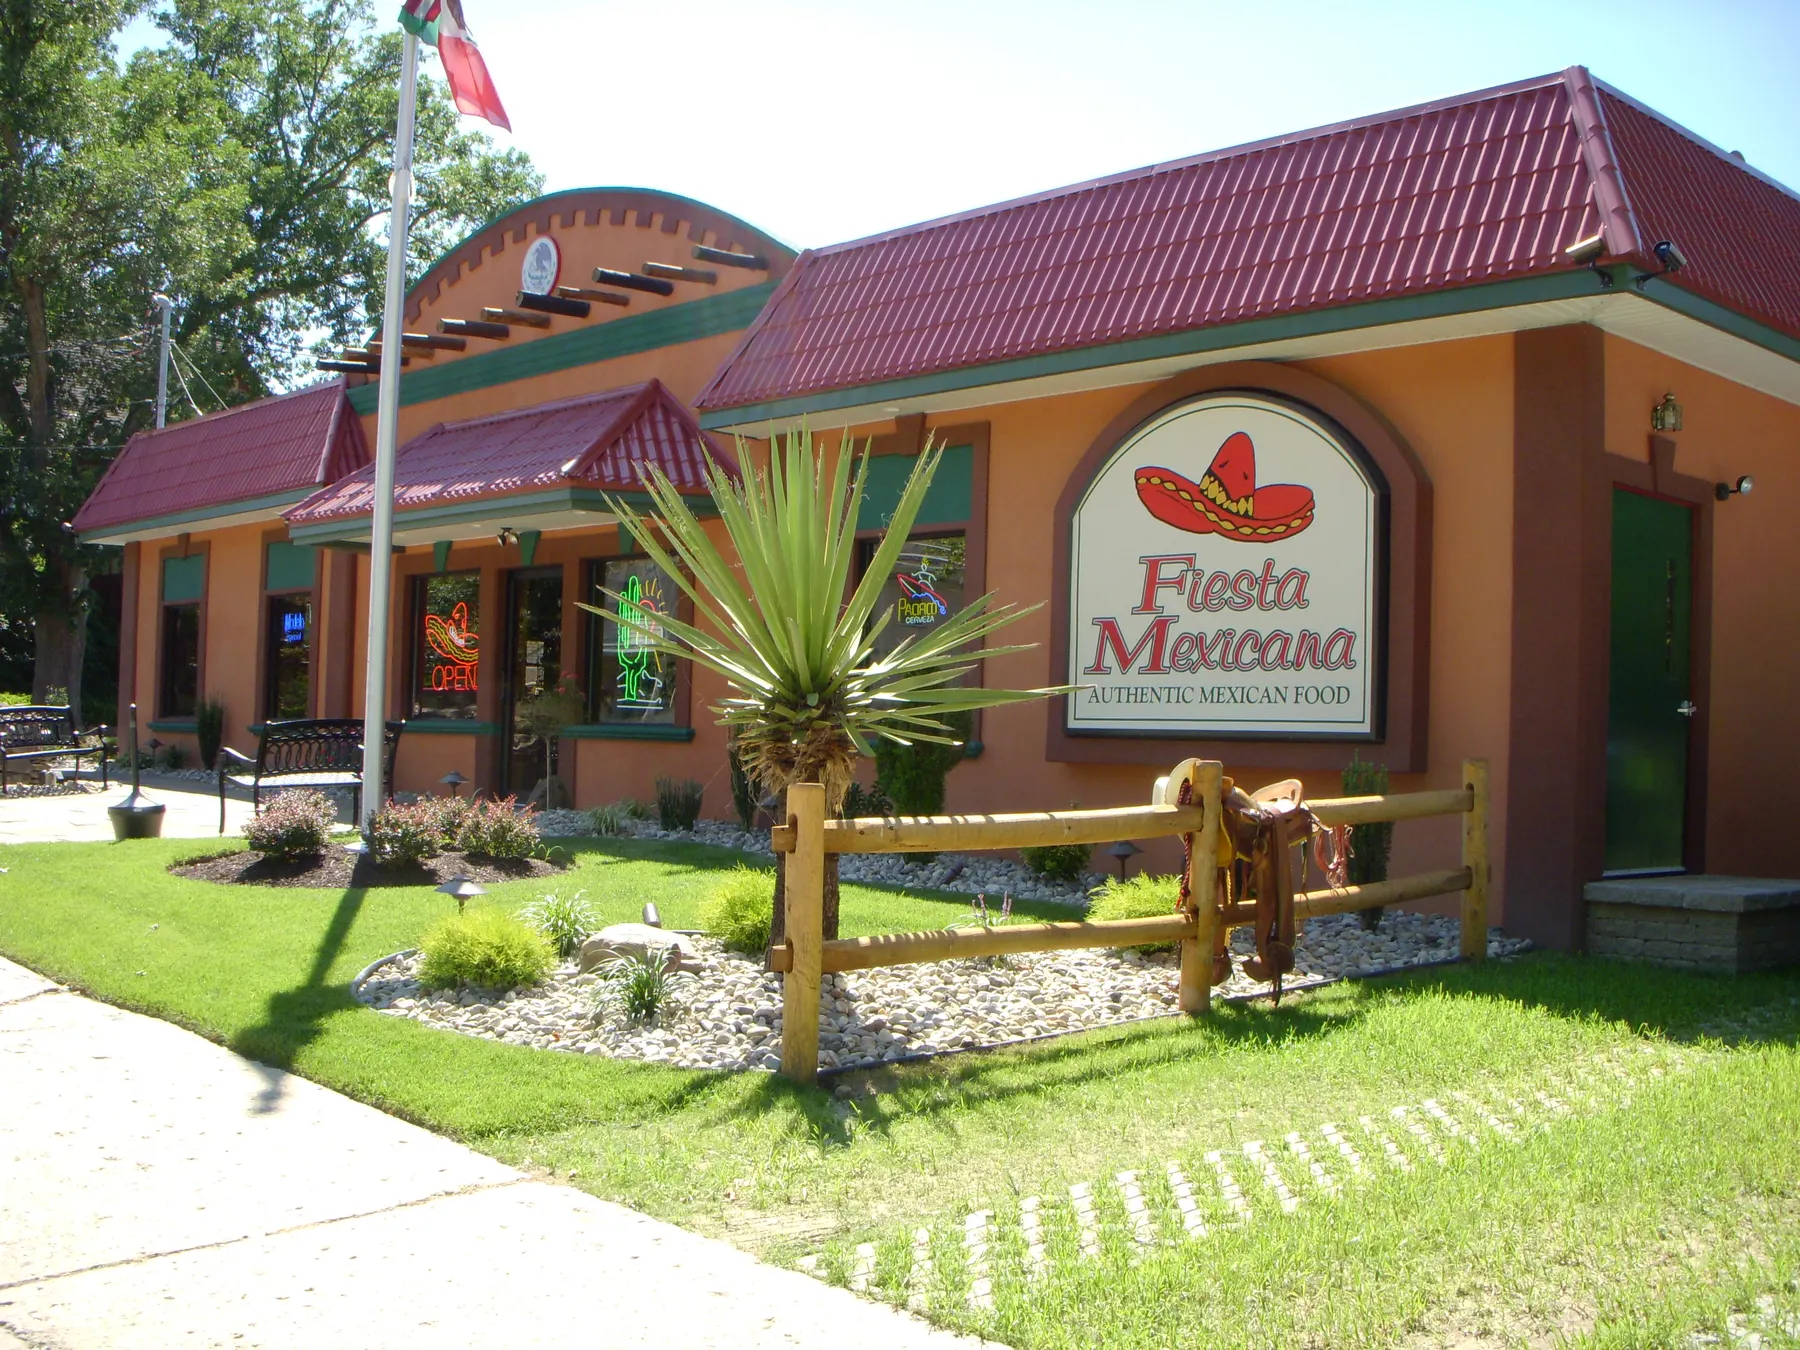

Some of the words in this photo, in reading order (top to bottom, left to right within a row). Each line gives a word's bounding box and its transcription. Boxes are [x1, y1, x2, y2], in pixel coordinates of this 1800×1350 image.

[1131, 553, 1310, 615] Fiesta
[905, 615, 935, 624] CERVEZA
[1084, 615, 1357, 675] Mexicana
[432, 665, 478, 691] OPEN
[1088, 686, 1195, 704] AUTHENTIC
[1199, 686, 1288, 704] MEXICAN
[1293, 685, 1351, 704] FOOD
